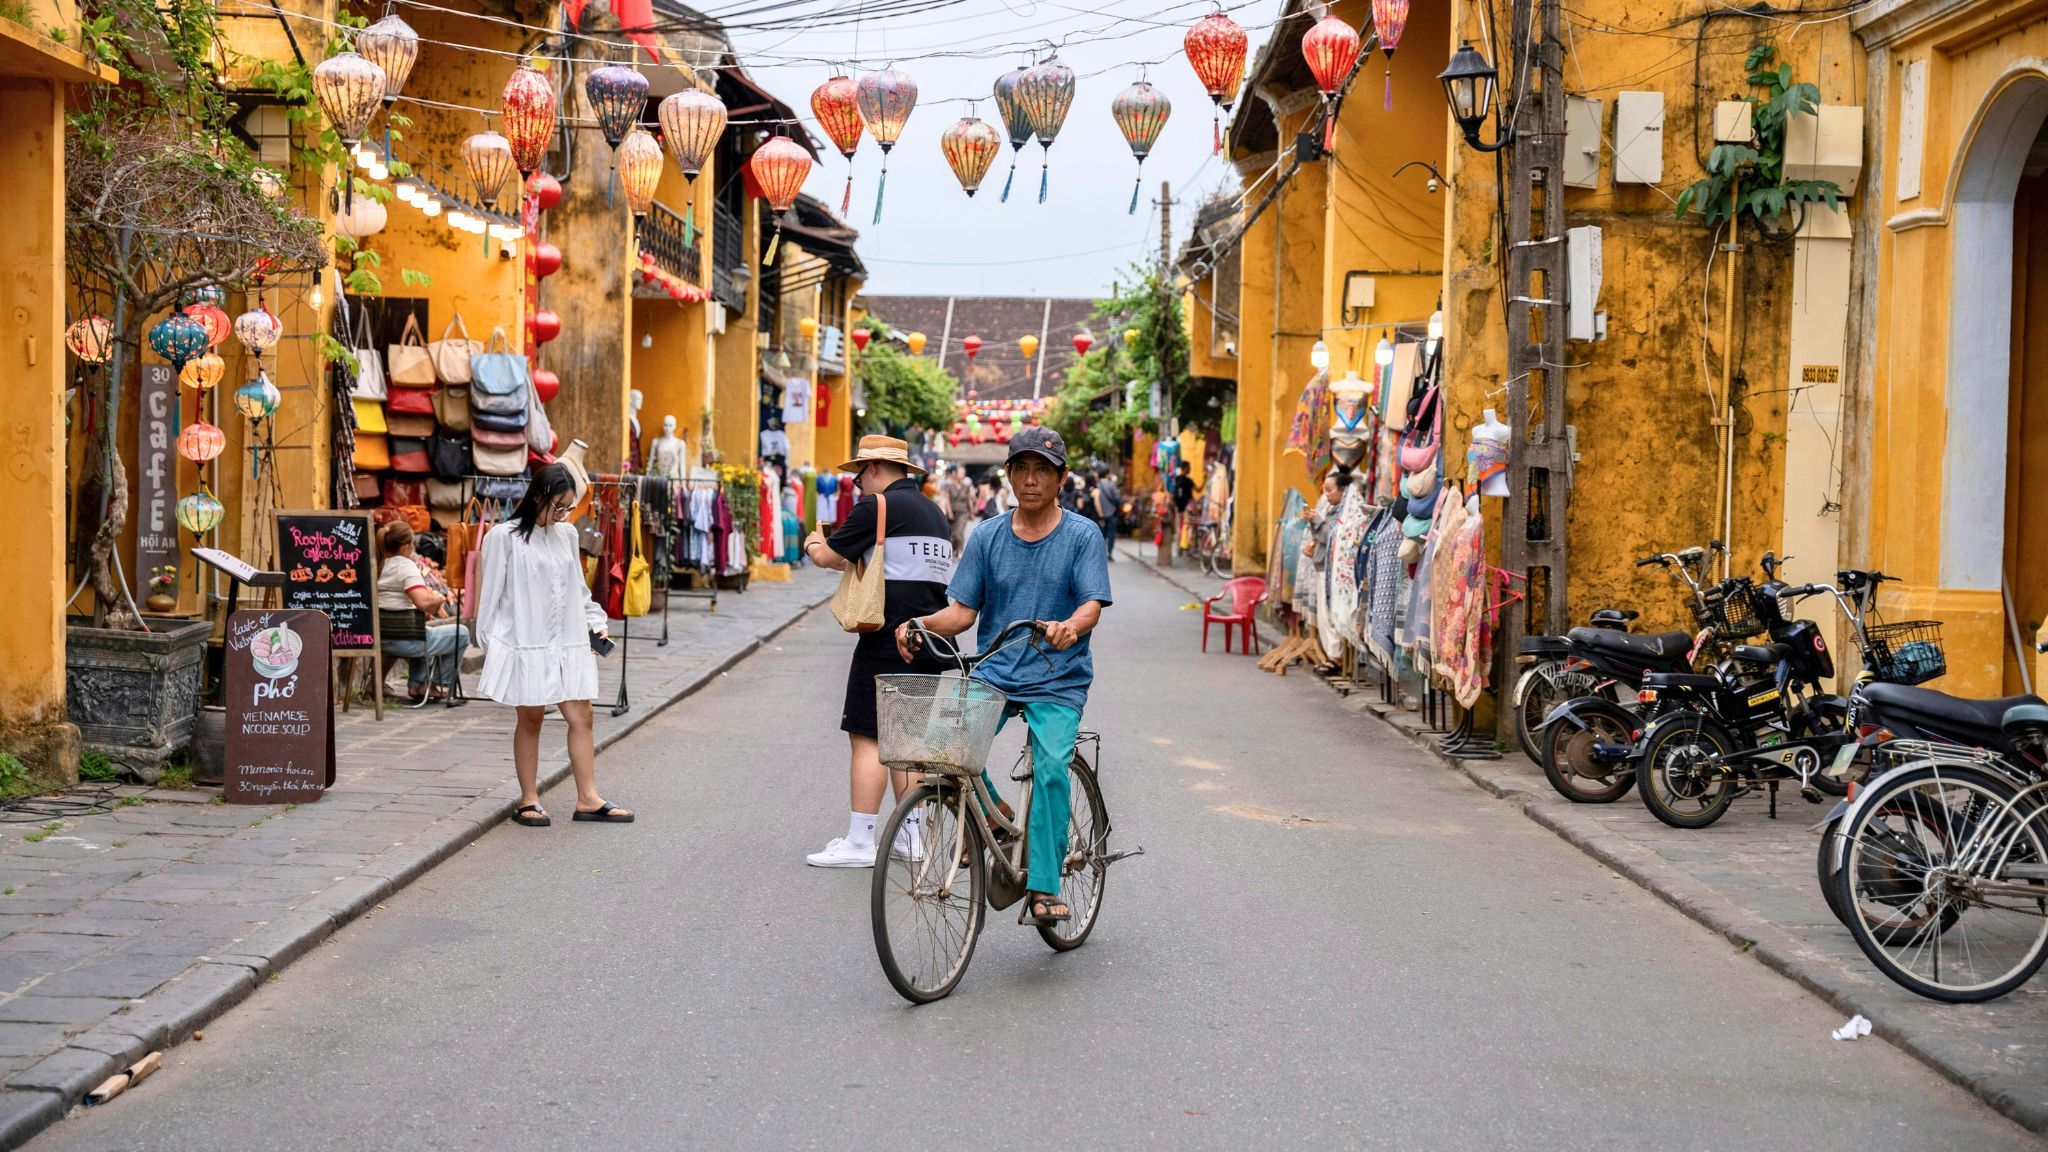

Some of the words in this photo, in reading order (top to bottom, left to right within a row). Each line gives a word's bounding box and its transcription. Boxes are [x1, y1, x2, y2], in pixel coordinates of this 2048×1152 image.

[152, 367, 170, 382] 30
[161, 537, 176, 548] AN
[259, 612, 275, 628] of
[242, 710, 310, 722] VIETNAMESE
[242, 723, 280, 735] NOODLE
[281, 723, 311, 736] SOUP
